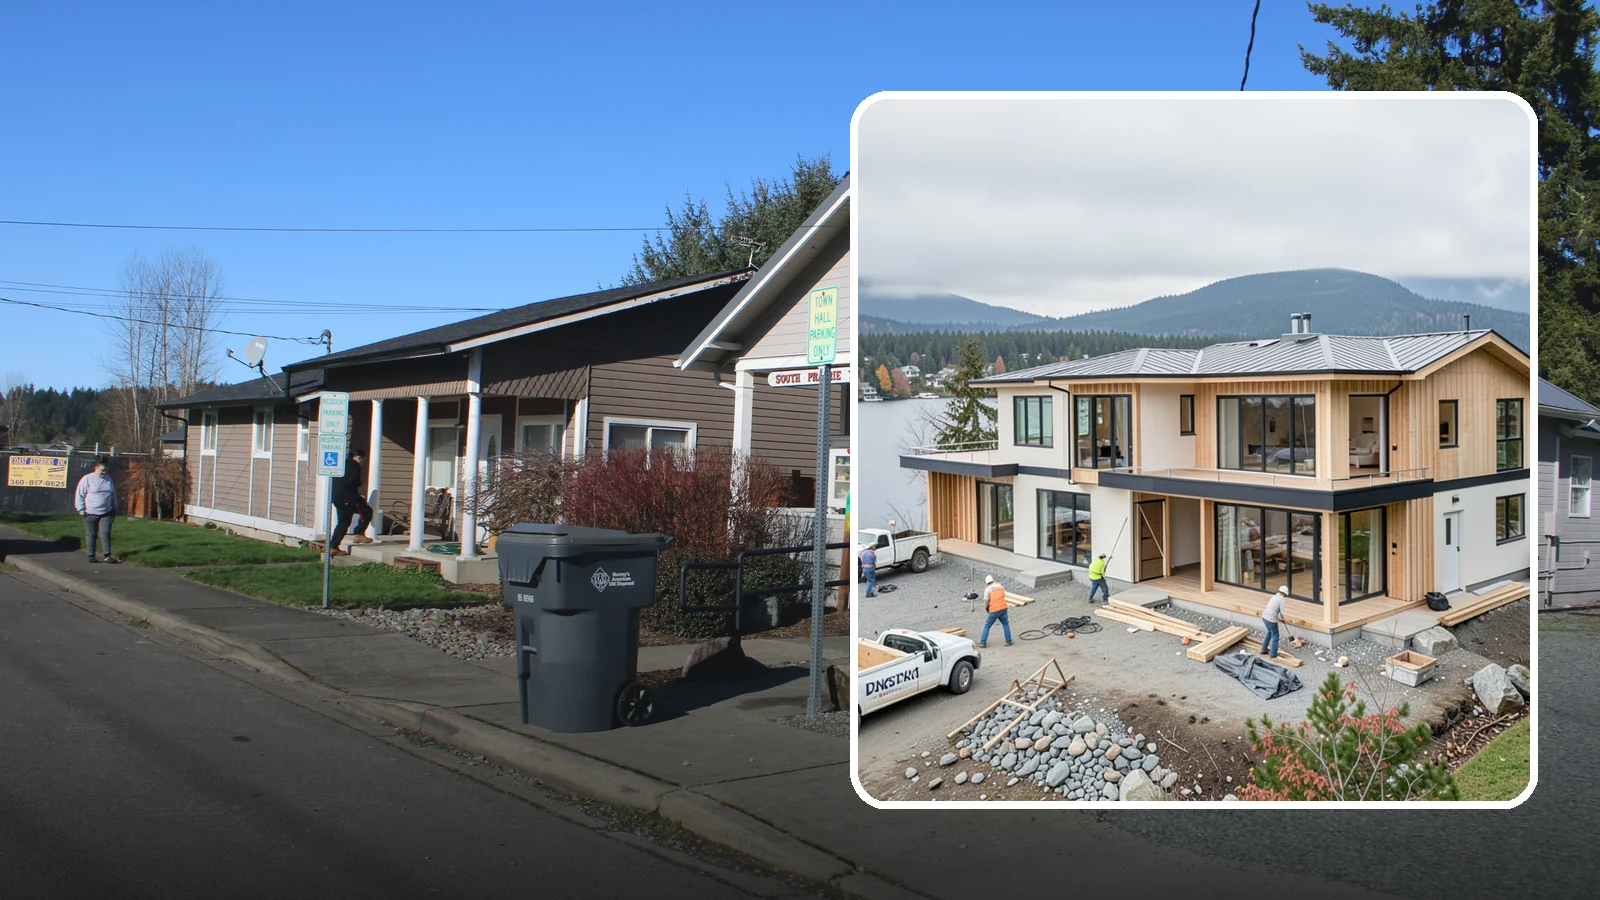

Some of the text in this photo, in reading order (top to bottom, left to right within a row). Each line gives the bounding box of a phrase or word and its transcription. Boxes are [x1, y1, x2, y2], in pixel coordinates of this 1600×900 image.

[815, 294, 833, 308] TOWN
[814, 311, 831, 325] HALL
[809, 326, 836, 341] PARKING
[813, 344, 831, 358] ONLY
[775, 373, 801, 384] SOUTH
